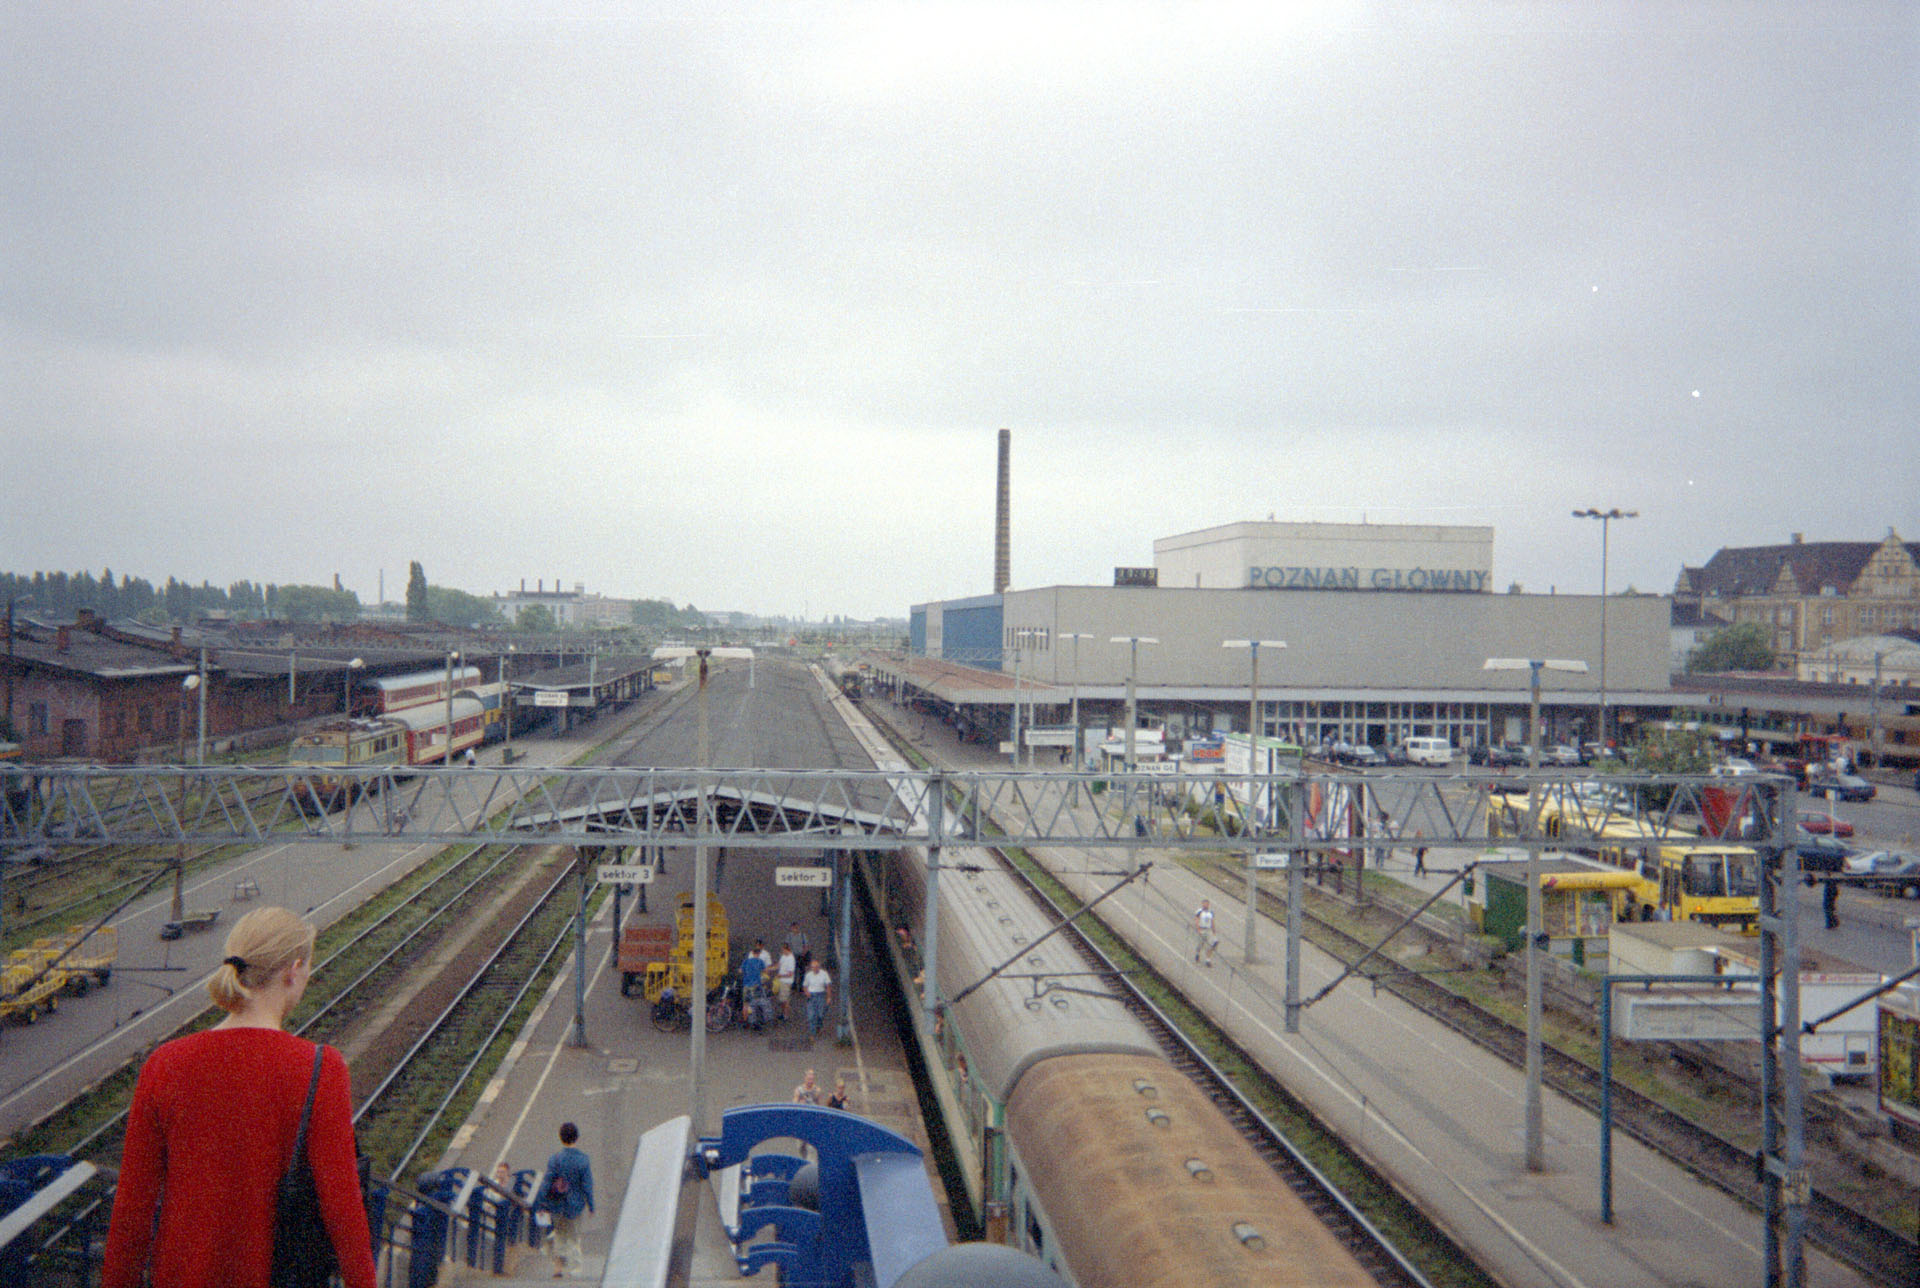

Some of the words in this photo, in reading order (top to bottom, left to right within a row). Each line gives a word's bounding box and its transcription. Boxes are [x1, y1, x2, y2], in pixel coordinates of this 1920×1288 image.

[1371, 567, 1488, 591] GŁÓWNY
[602, 870, 638, 879] sektor
[643, 869, 650, 879] 3
[780, 871, 816, 881] sektor
[820, 871, 828, 881] 3
